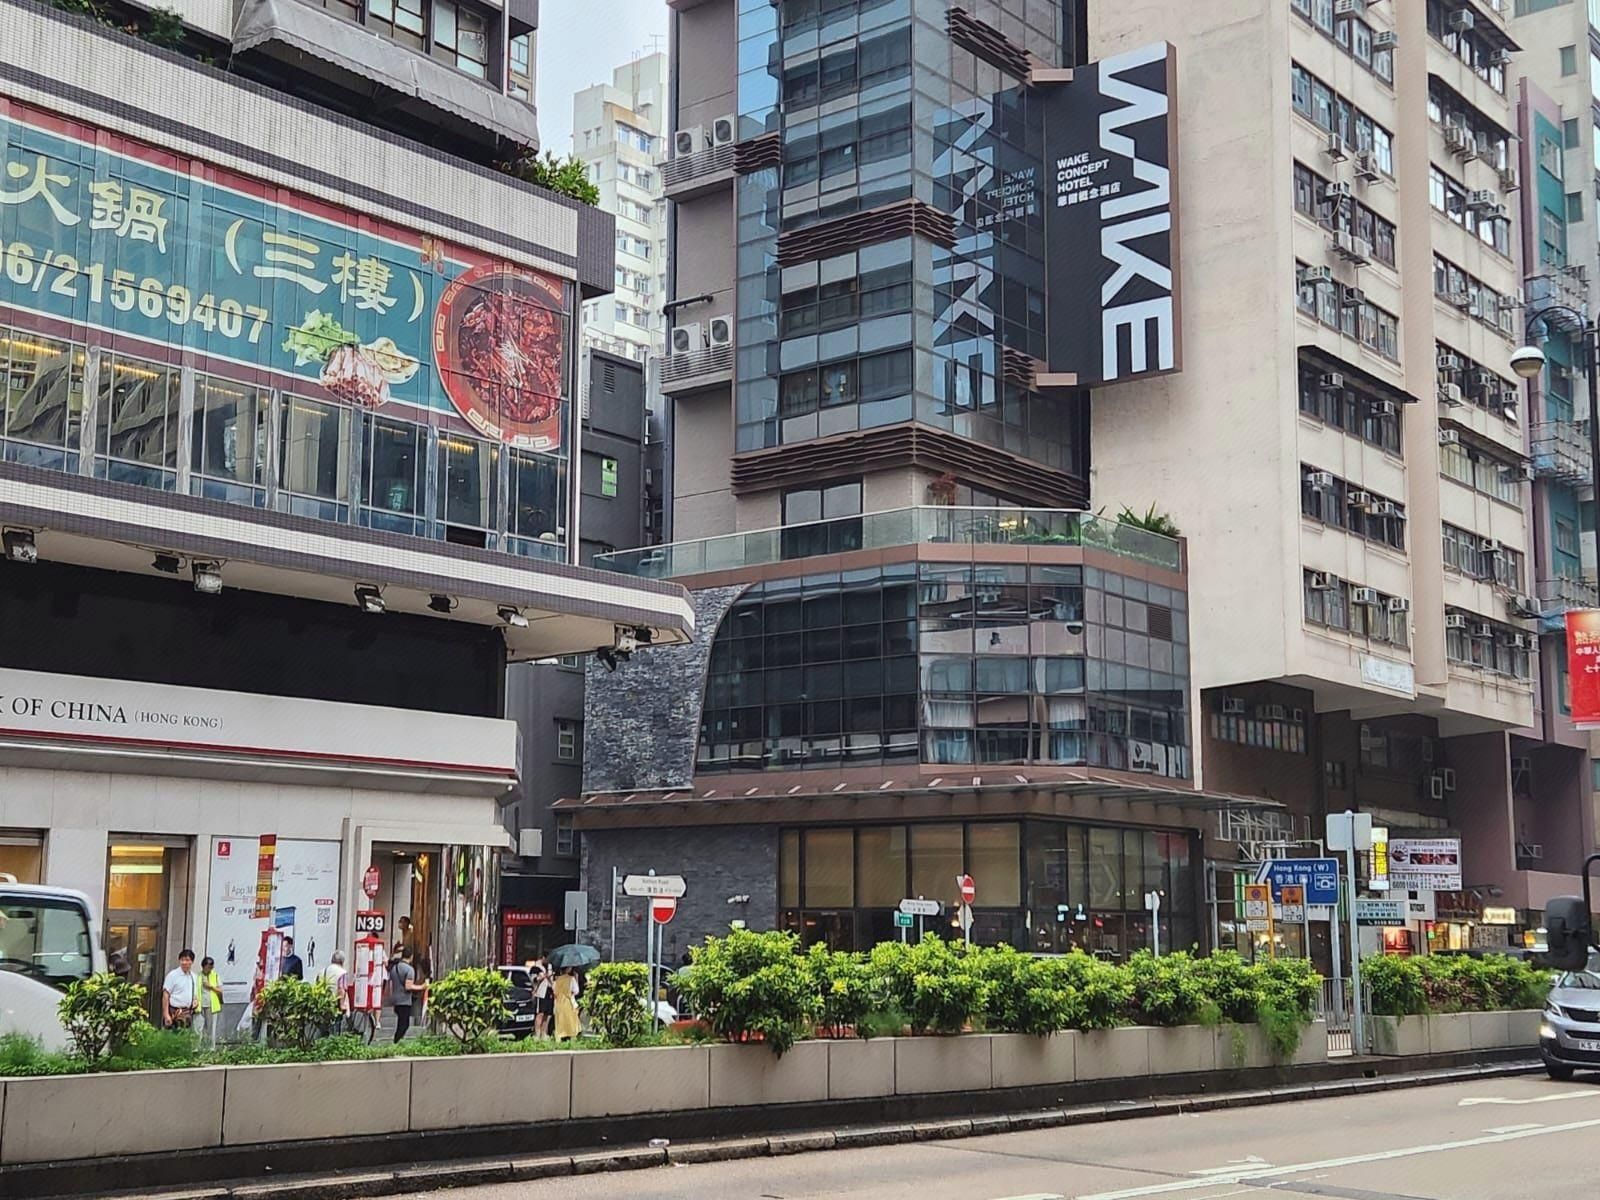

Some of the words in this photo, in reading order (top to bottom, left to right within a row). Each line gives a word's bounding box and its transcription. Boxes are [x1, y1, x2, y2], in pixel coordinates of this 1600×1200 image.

[1057, 152, 1089, 169] WAKE
[1057, 159, 1110, 182] CONCEPT
[1057, 176, 1094, 194] HOTEL
[1098, 40, 1174, 382] WAKE
[0, 241, 269, 345] 6/21569407
[12, 697, 43, 716] OF
[51, 700, 128, 723] CHINA
[135, 710, 178, 725] (HONG
[183, 713, 224, 730] KONG)
[1274, 864, 1293, 873] Hong
[1294, 864, 1312, 873] Kong
[1313, 863, 1329, 872] (W)
[357, 916, 384, 931] N39
